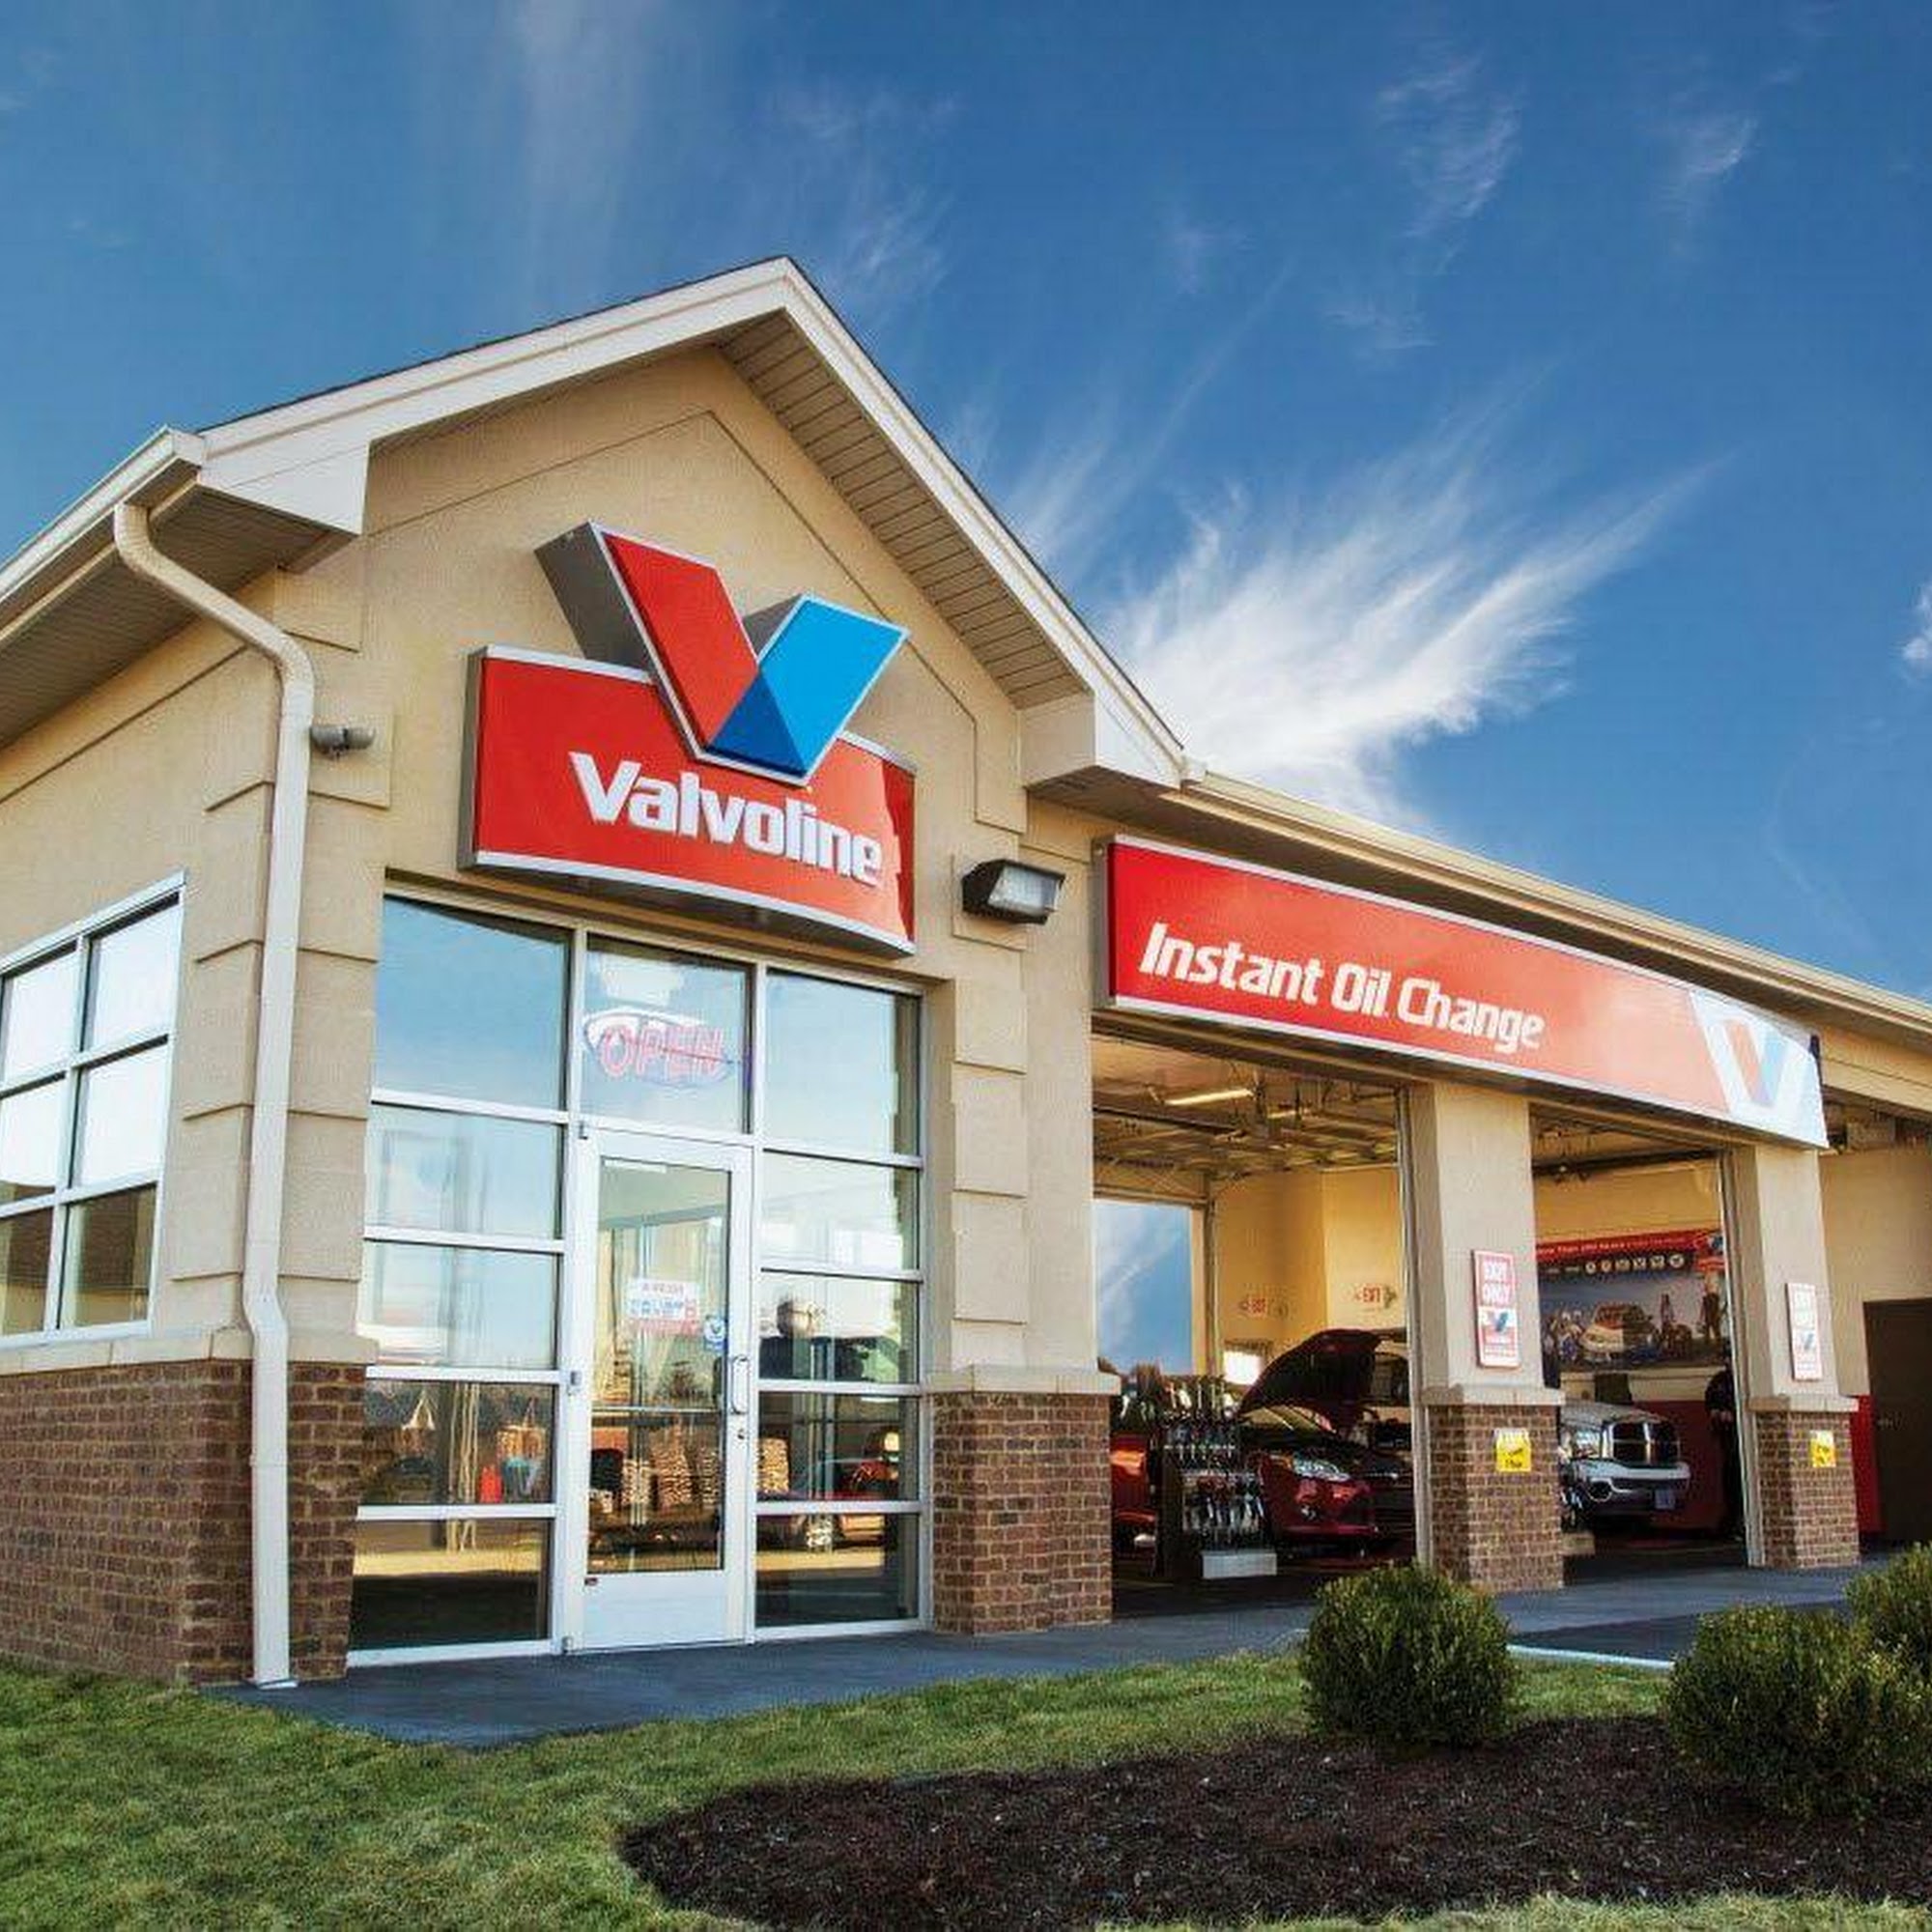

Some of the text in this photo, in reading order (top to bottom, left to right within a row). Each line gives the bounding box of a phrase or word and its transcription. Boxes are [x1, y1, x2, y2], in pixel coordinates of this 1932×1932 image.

[568, 752, 884, 887] Valvoline
[599, 1024, 724, 1078] OPEN
[1139, 922, 1546, 1055] Instant Oil Change
